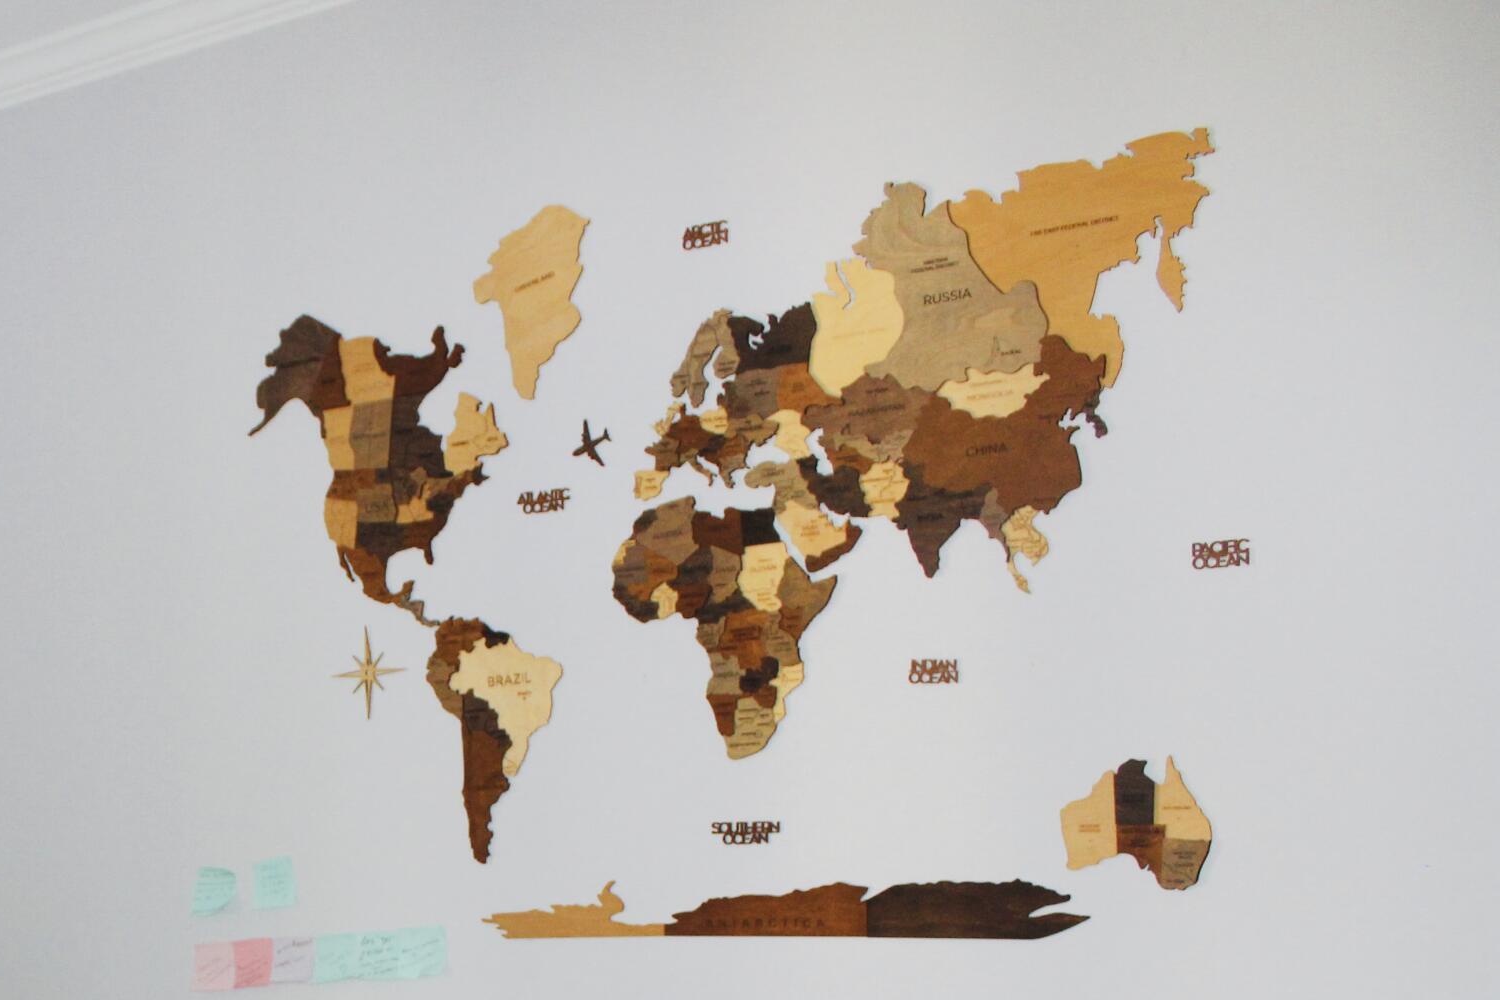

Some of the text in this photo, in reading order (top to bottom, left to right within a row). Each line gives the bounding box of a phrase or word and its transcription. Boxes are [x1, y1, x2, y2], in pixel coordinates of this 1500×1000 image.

[683, 229, 728, 250] OCEAN
[923, 288, 972, 305] RUSSIA
[966, 442, 1008, 457] CHINA
[517, 487, 570, 504] ATLANTIC
[523, 498, 564, 514] OCEAN
[1192, 538, 1249, 557] PACIFIC
[1192, 548, 1250, 569] OCEAN
[911, 659, 957, 673] INDIAN
[487, 672, 531, 688] BRAZIL
[909, 670, 958, 684] OCEAN
[711, 821, 780, 834] SOUTHERN
[723, 831, 768, 845] OCEAN
